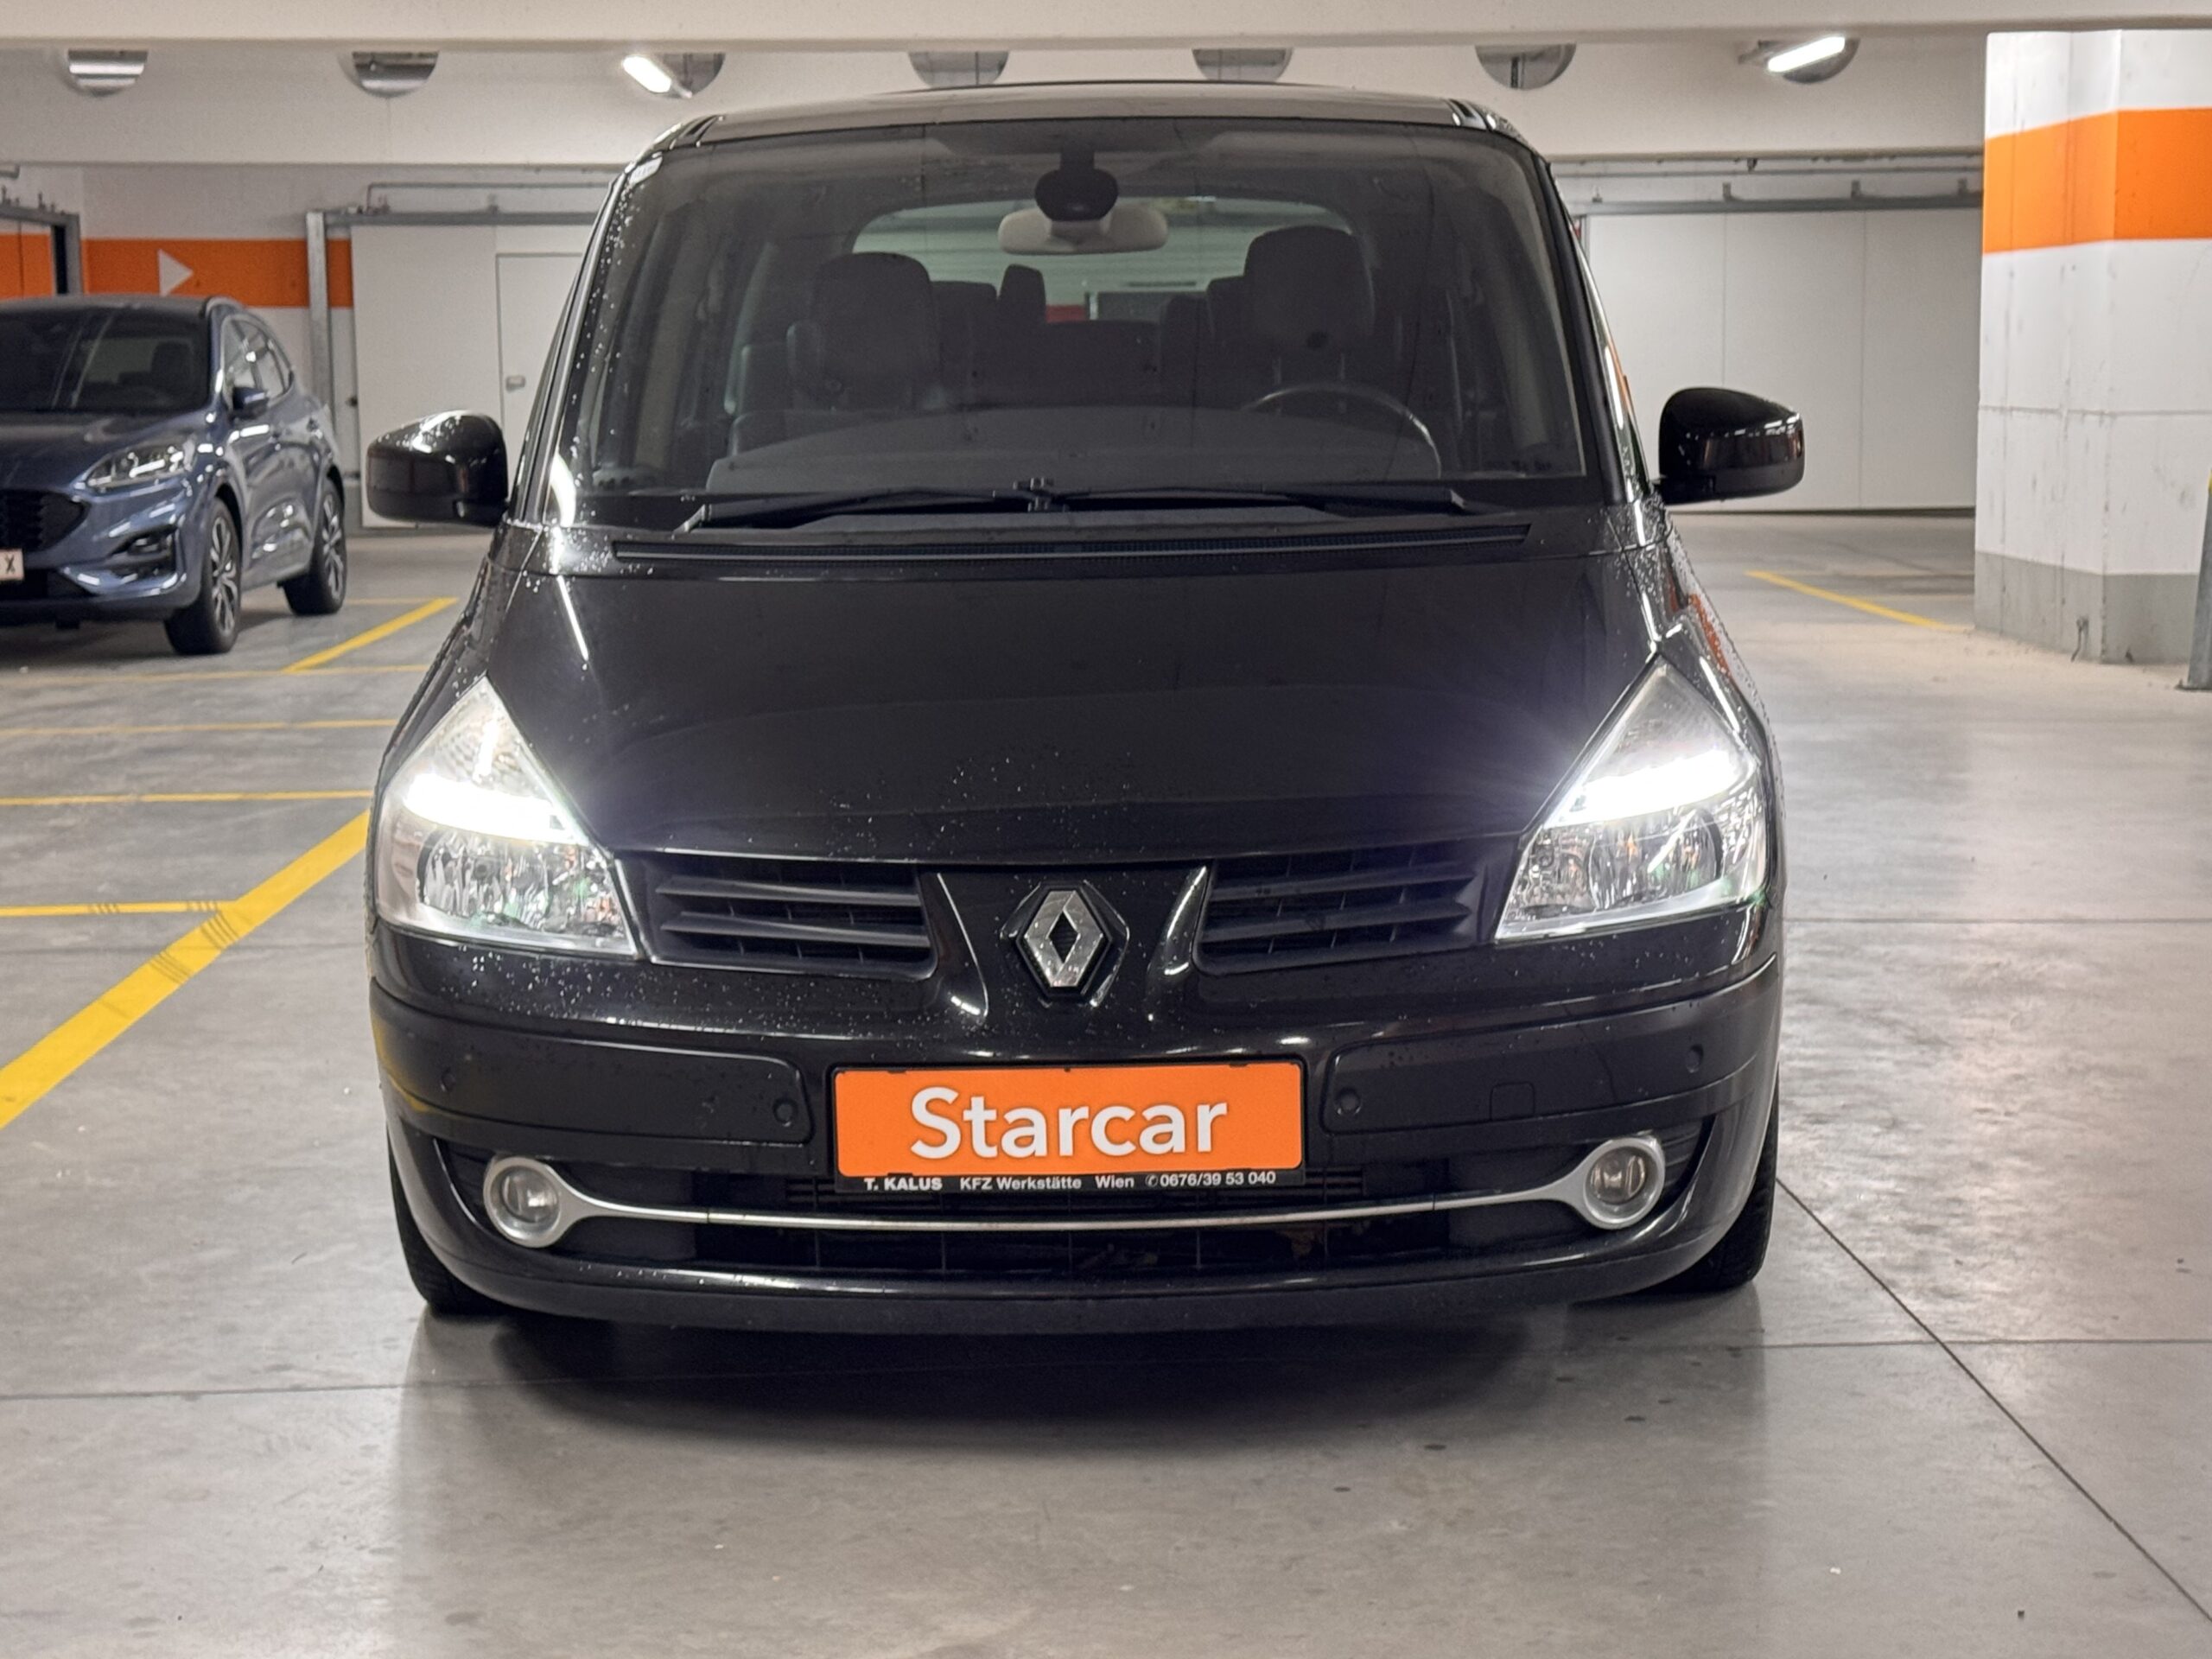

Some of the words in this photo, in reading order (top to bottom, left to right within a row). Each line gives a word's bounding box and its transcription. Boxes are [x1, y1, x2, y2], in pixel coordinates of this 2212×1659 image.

[910, 1086, 1227, 1159] Starcar
[864, 1177, 879, 1191] T.
[884, 1177, 943, 1191] KALUS
[961, 1176, 993, 1191] KFZ
[996, 1175, 1082, 1190] Werkstätte
[1095, 1174, 1135, 1189] Wien
[1160, 1173, 1222, 1186] 0676/39
[1225, 1171, 1244, 1185] 53
[1248, 1171, 1276, 1184] 040
